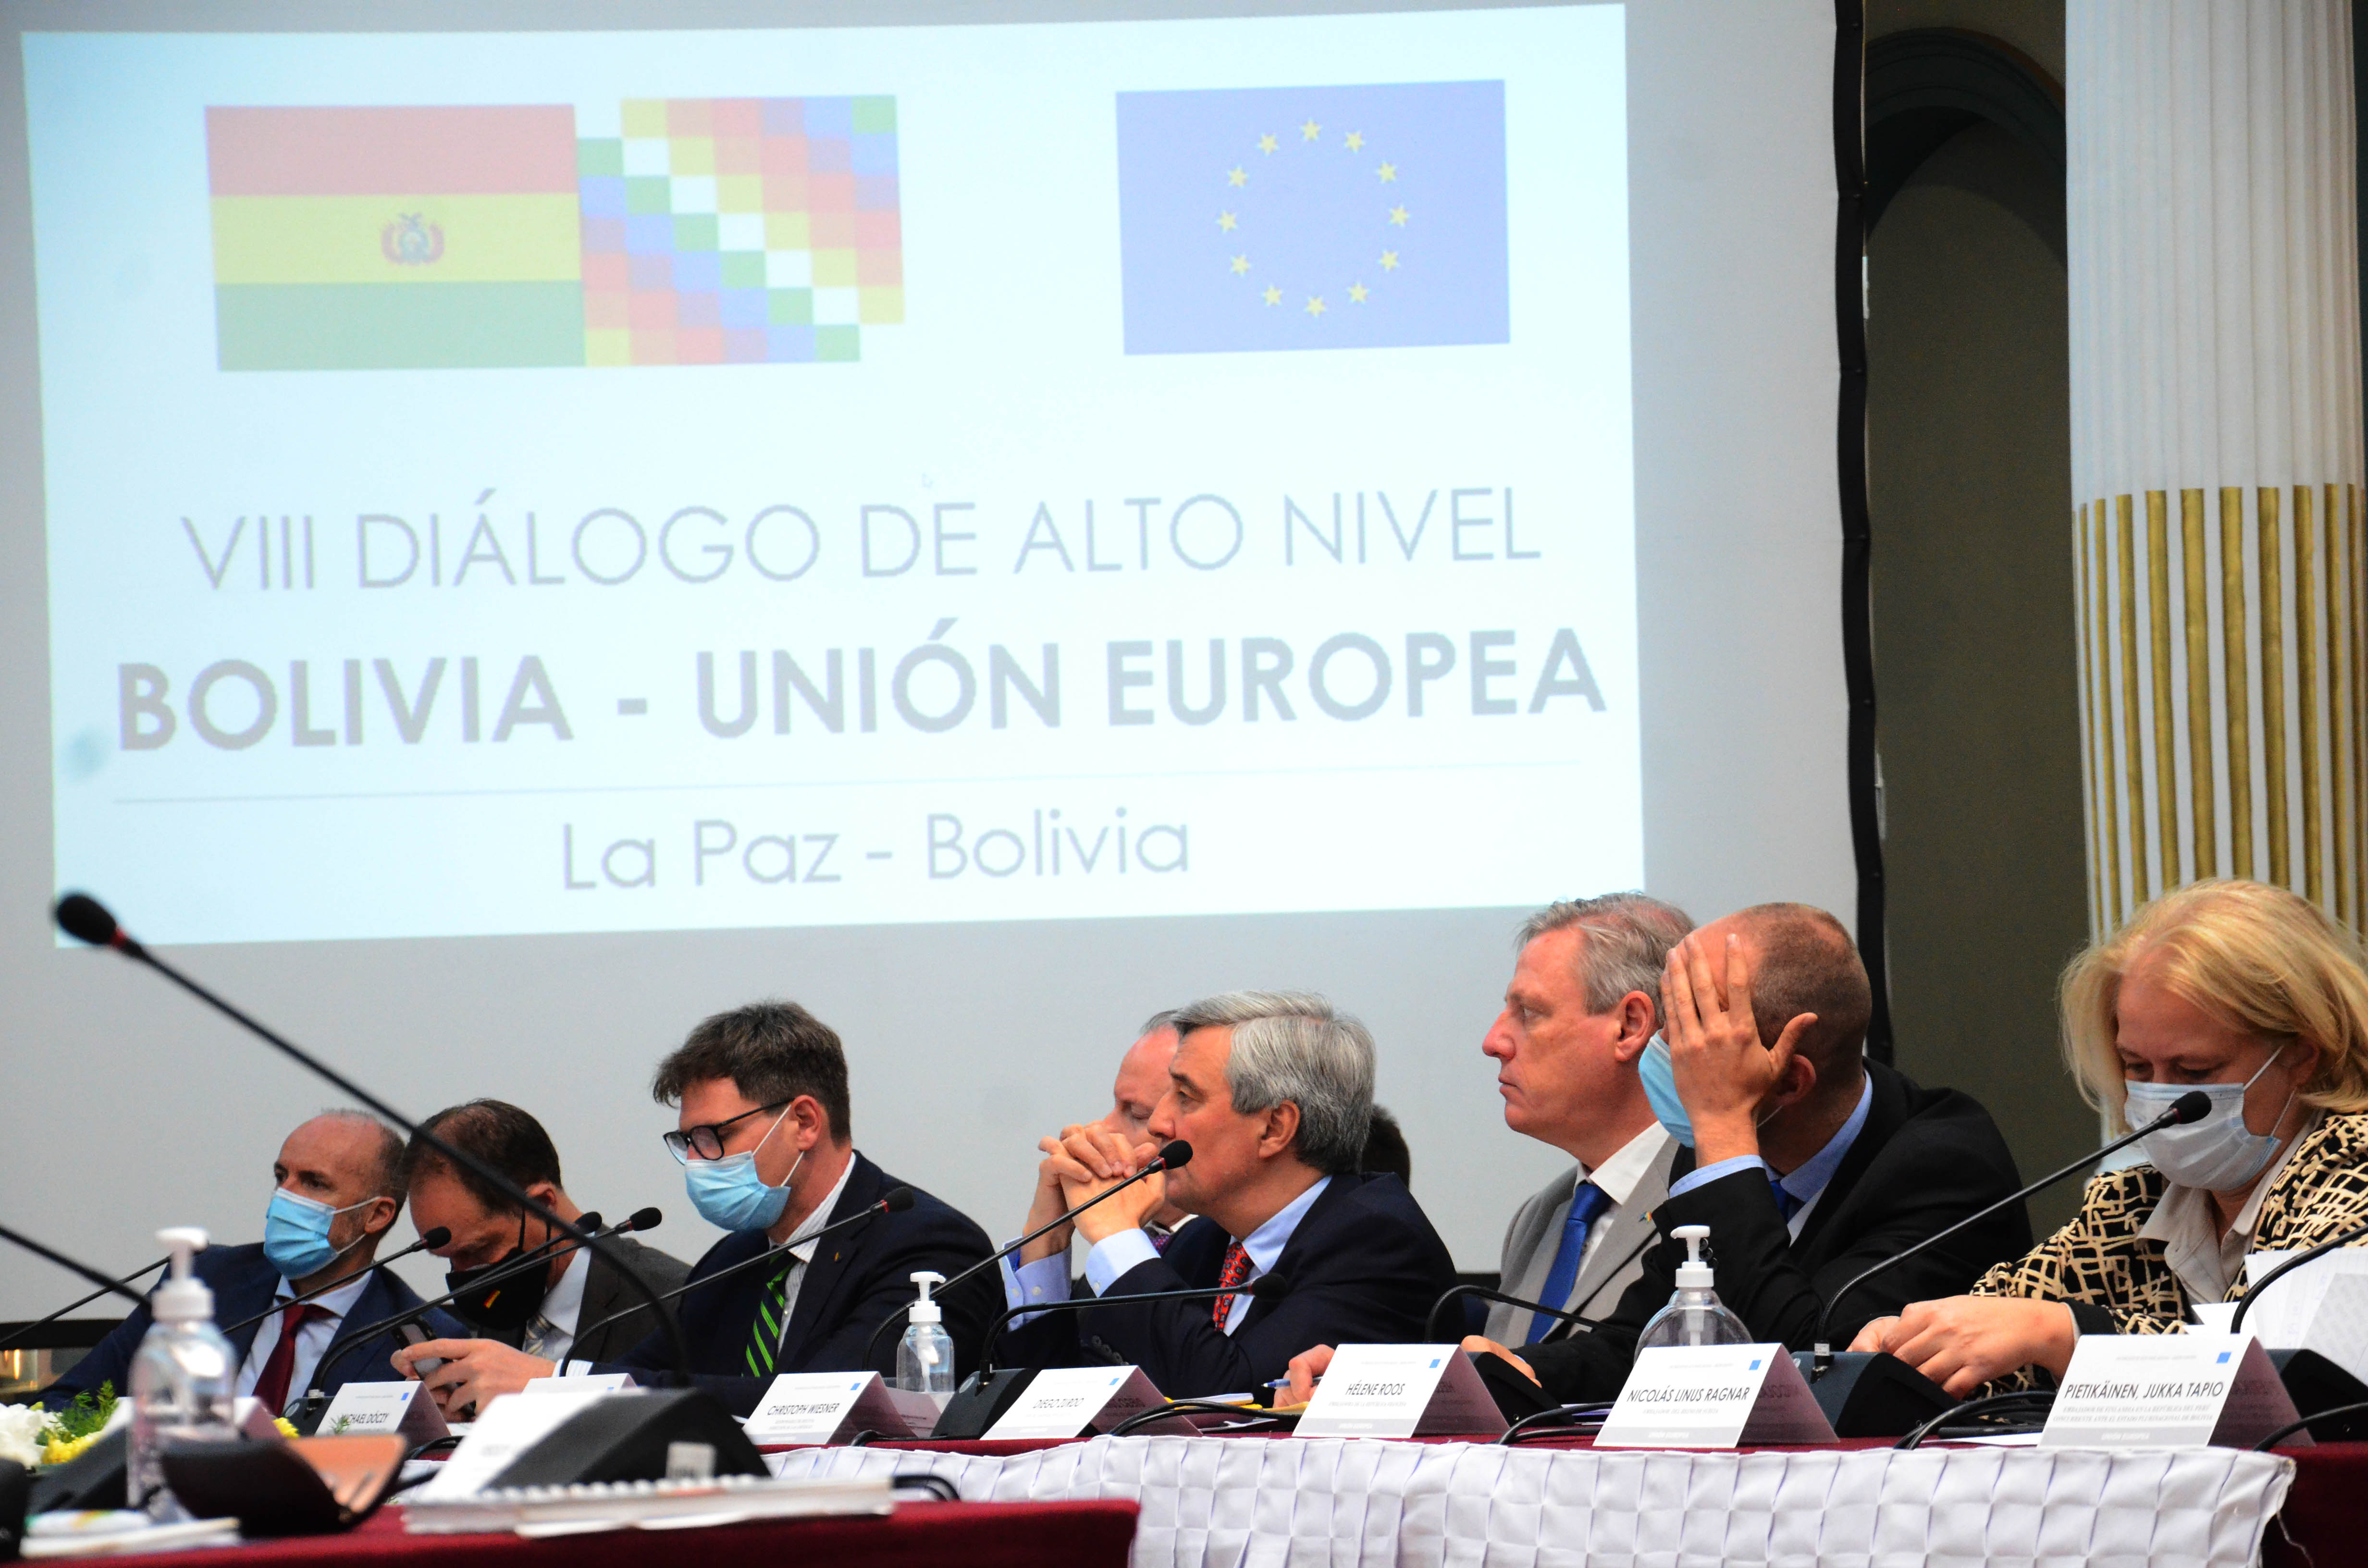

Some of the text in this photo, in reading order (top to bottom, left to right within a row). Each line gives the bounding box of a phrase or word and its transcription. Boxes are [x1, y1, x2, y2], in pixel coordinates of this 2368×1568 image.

[182, 487, 1542, 590] VIII DIÁLOGO DE ALTO NIVEL
[119, 617, 1607, 750] BOLIVIA - UNIÓN EUROPEA
[564, 806, 1189, 890] La Paz - Bolivia
[1345, 1379, 1406, 1396] HÉLENE ROOS
[1627, 1384, 1674, 1402] NICOLÁS
[1674, 1388, 1704, 1402] LINUS
[1704, 1387, 1750, 1402] RAGNAR
[2064, 1380, 2224, 1400] PIETIKÄINEN, JUKKA TAPIO
[767, 1403, 840, 1416] CHRISTOPH WIESNER
[1033, 1399, 1060, 1409] DIEGO
